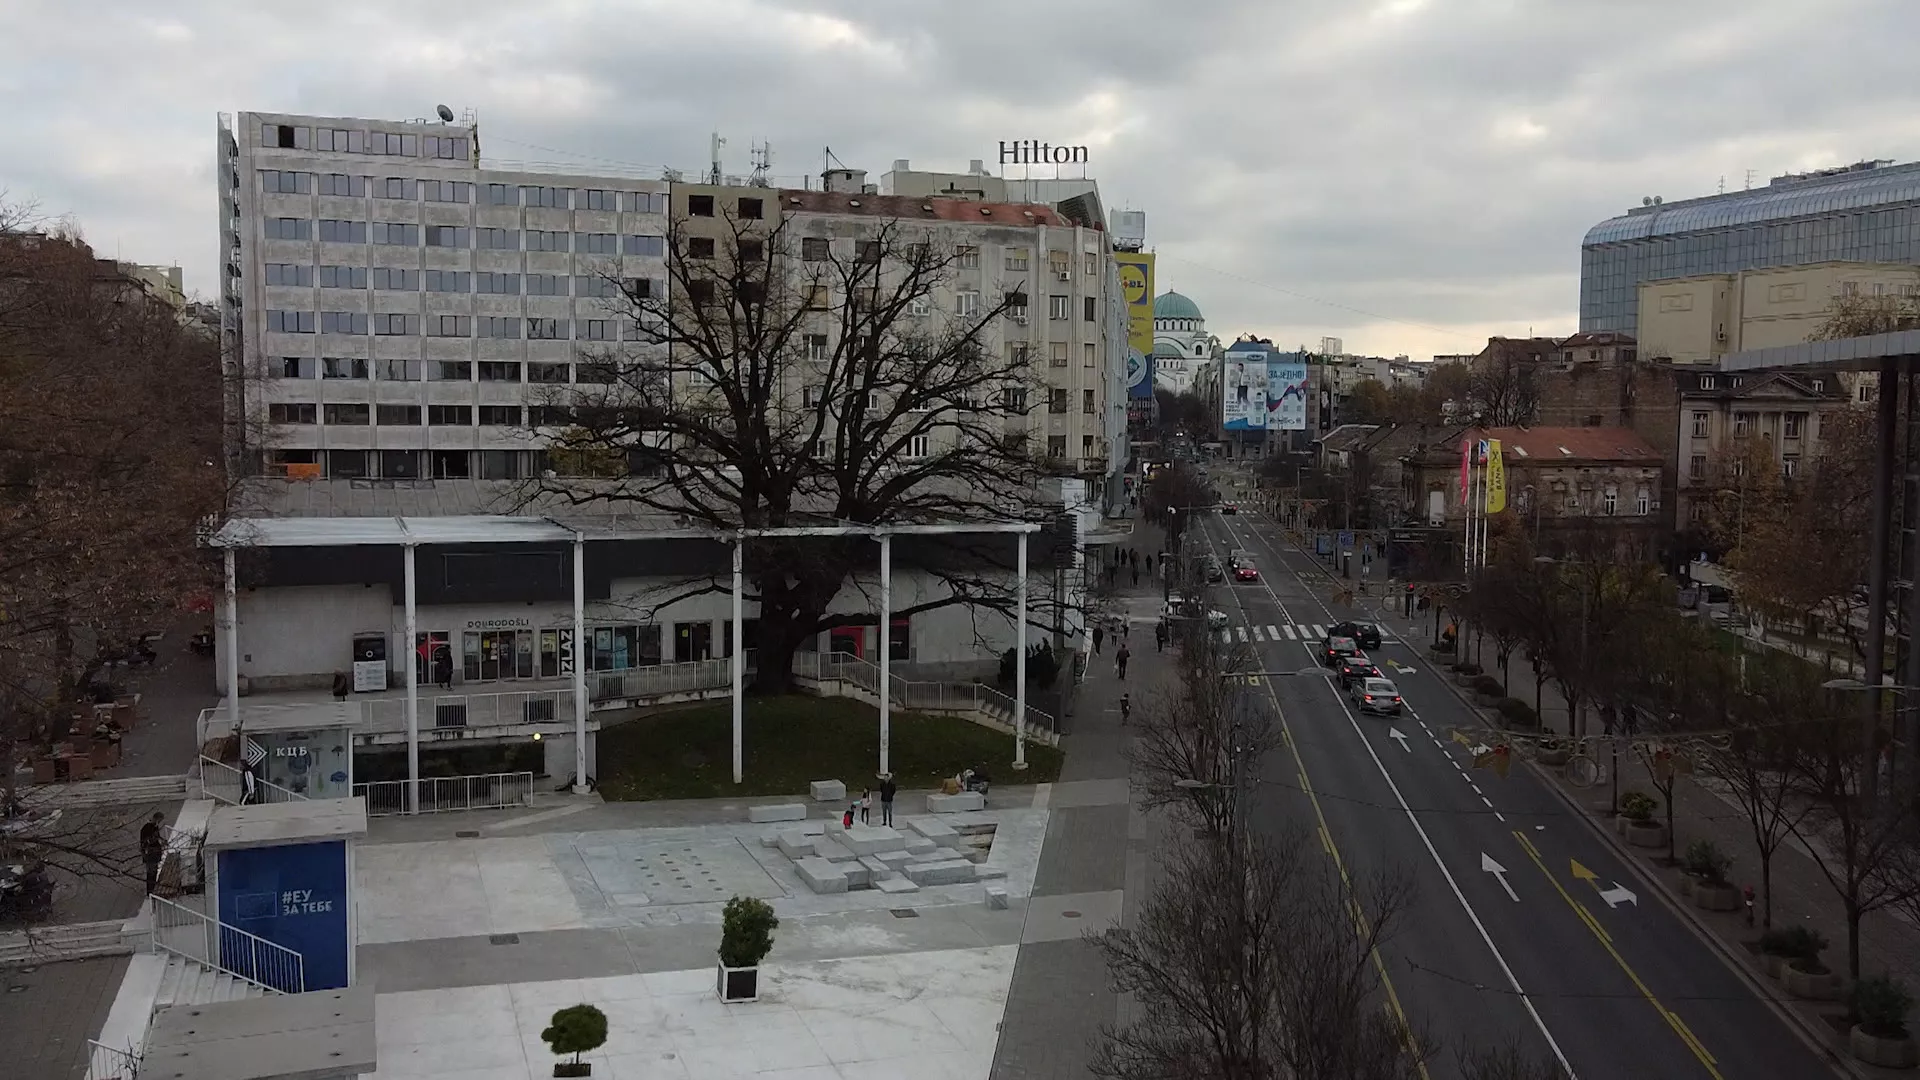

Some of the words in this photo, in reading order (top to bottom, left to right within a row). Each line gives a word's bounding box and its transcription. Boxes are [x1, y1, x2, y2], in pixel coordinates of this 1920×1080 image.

[999, 140, 1088, 164] Hilton
[561, 630, 574, 677] IZLAZ
[276, 746, 308, 757] КЦБ
[282, 889, 312, 904] #ЕУ
[283, 904, 299, 915] ЗА
